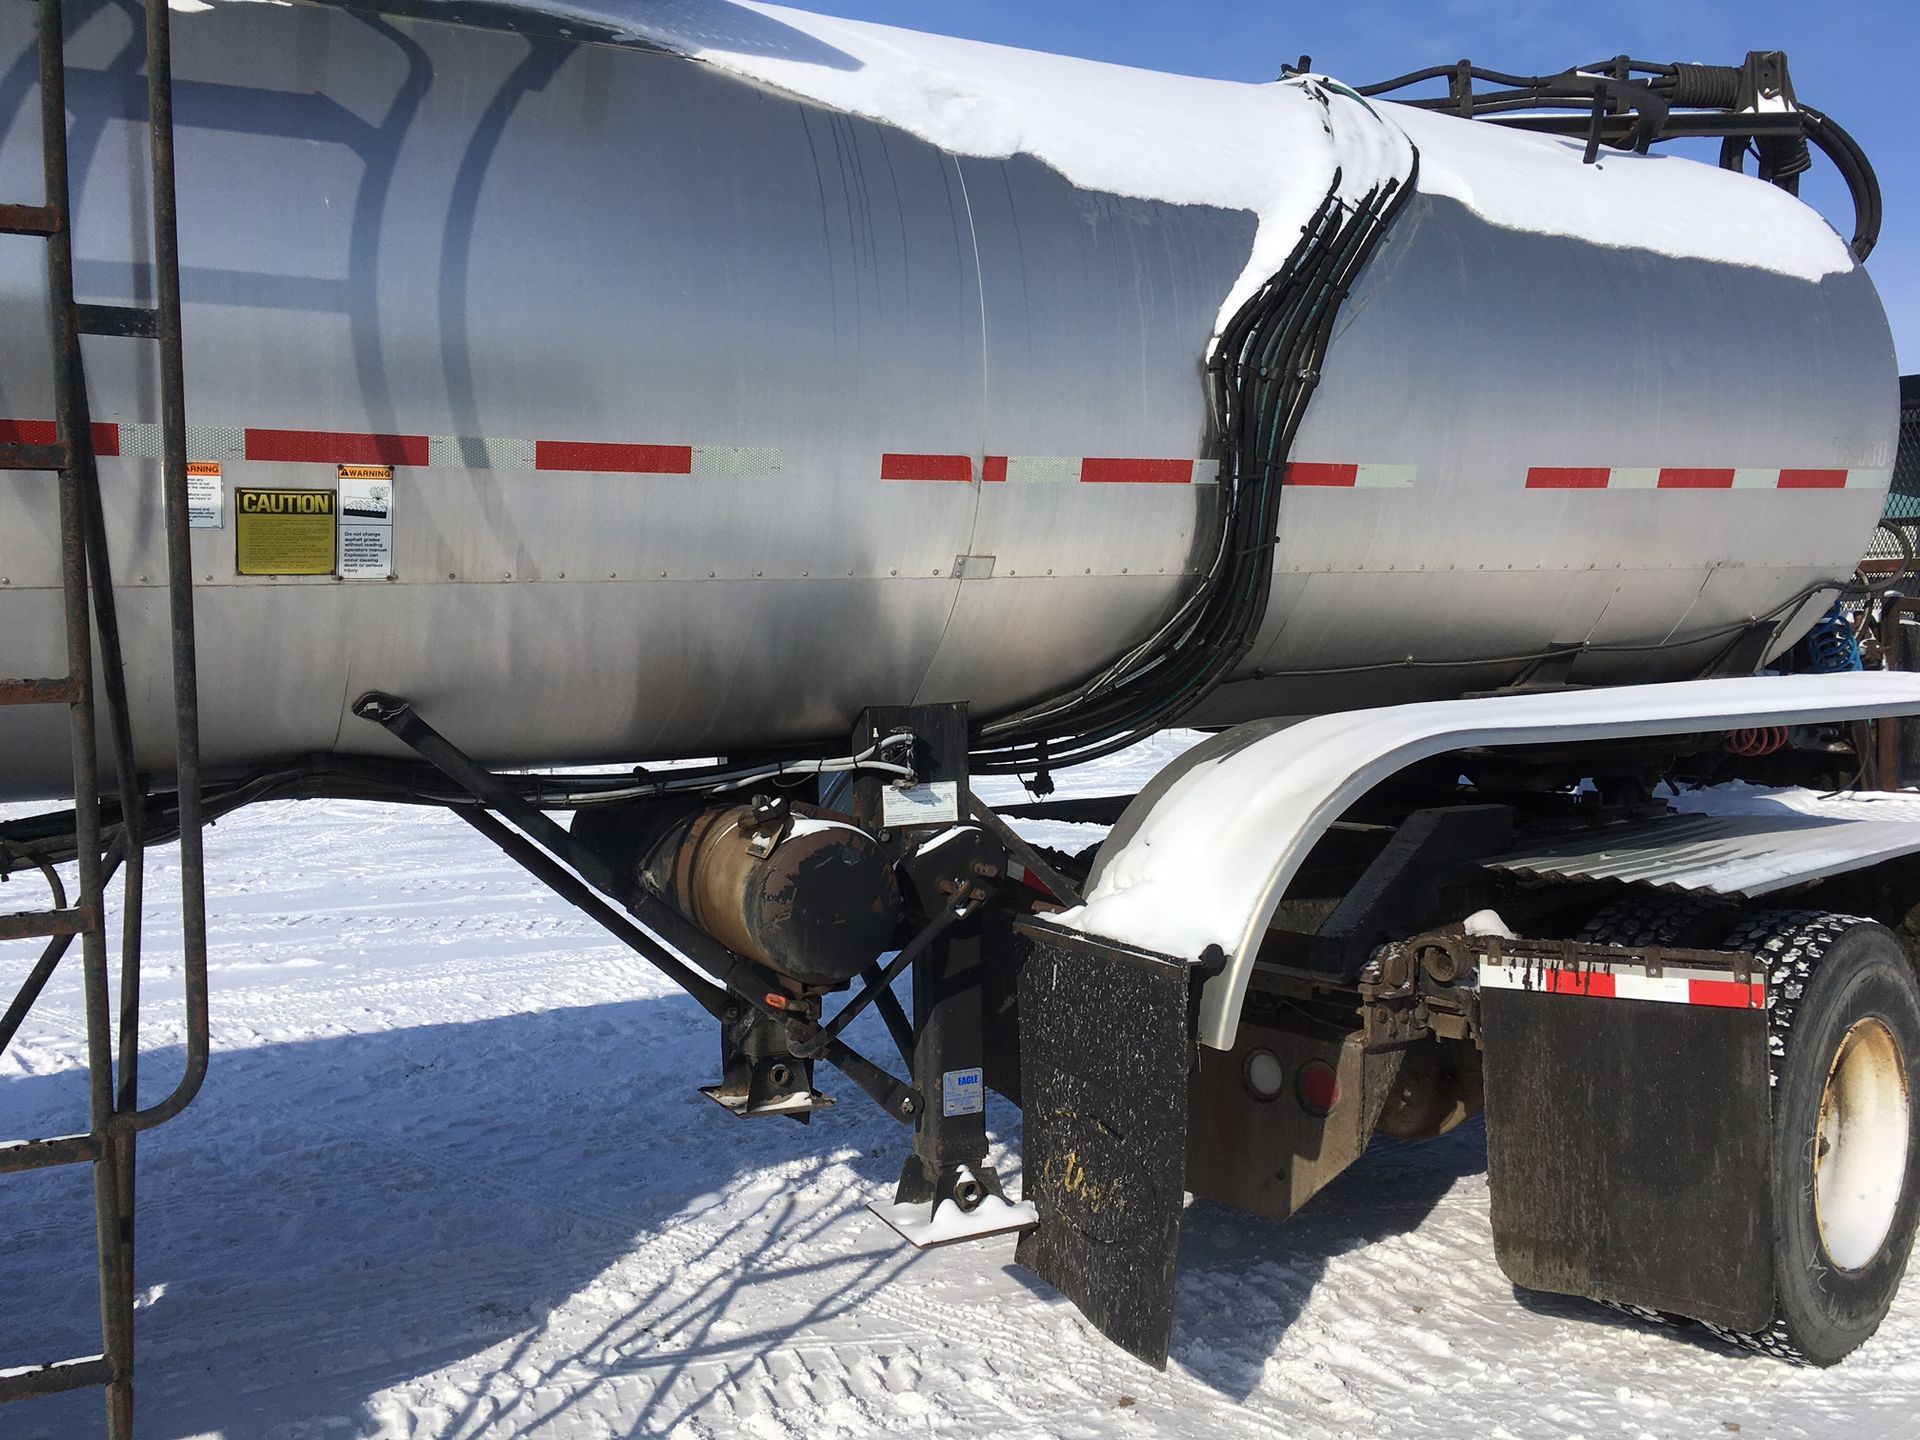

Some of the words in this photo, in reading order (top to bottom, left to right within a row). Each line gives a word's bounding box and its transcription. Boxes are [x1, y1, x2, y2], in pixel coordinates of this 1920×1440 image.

[187, 465, 219, 473] ARNING
[243, 494, 328, 513] CAUTION
[958, 1075, 978, 1086] EAGLE
